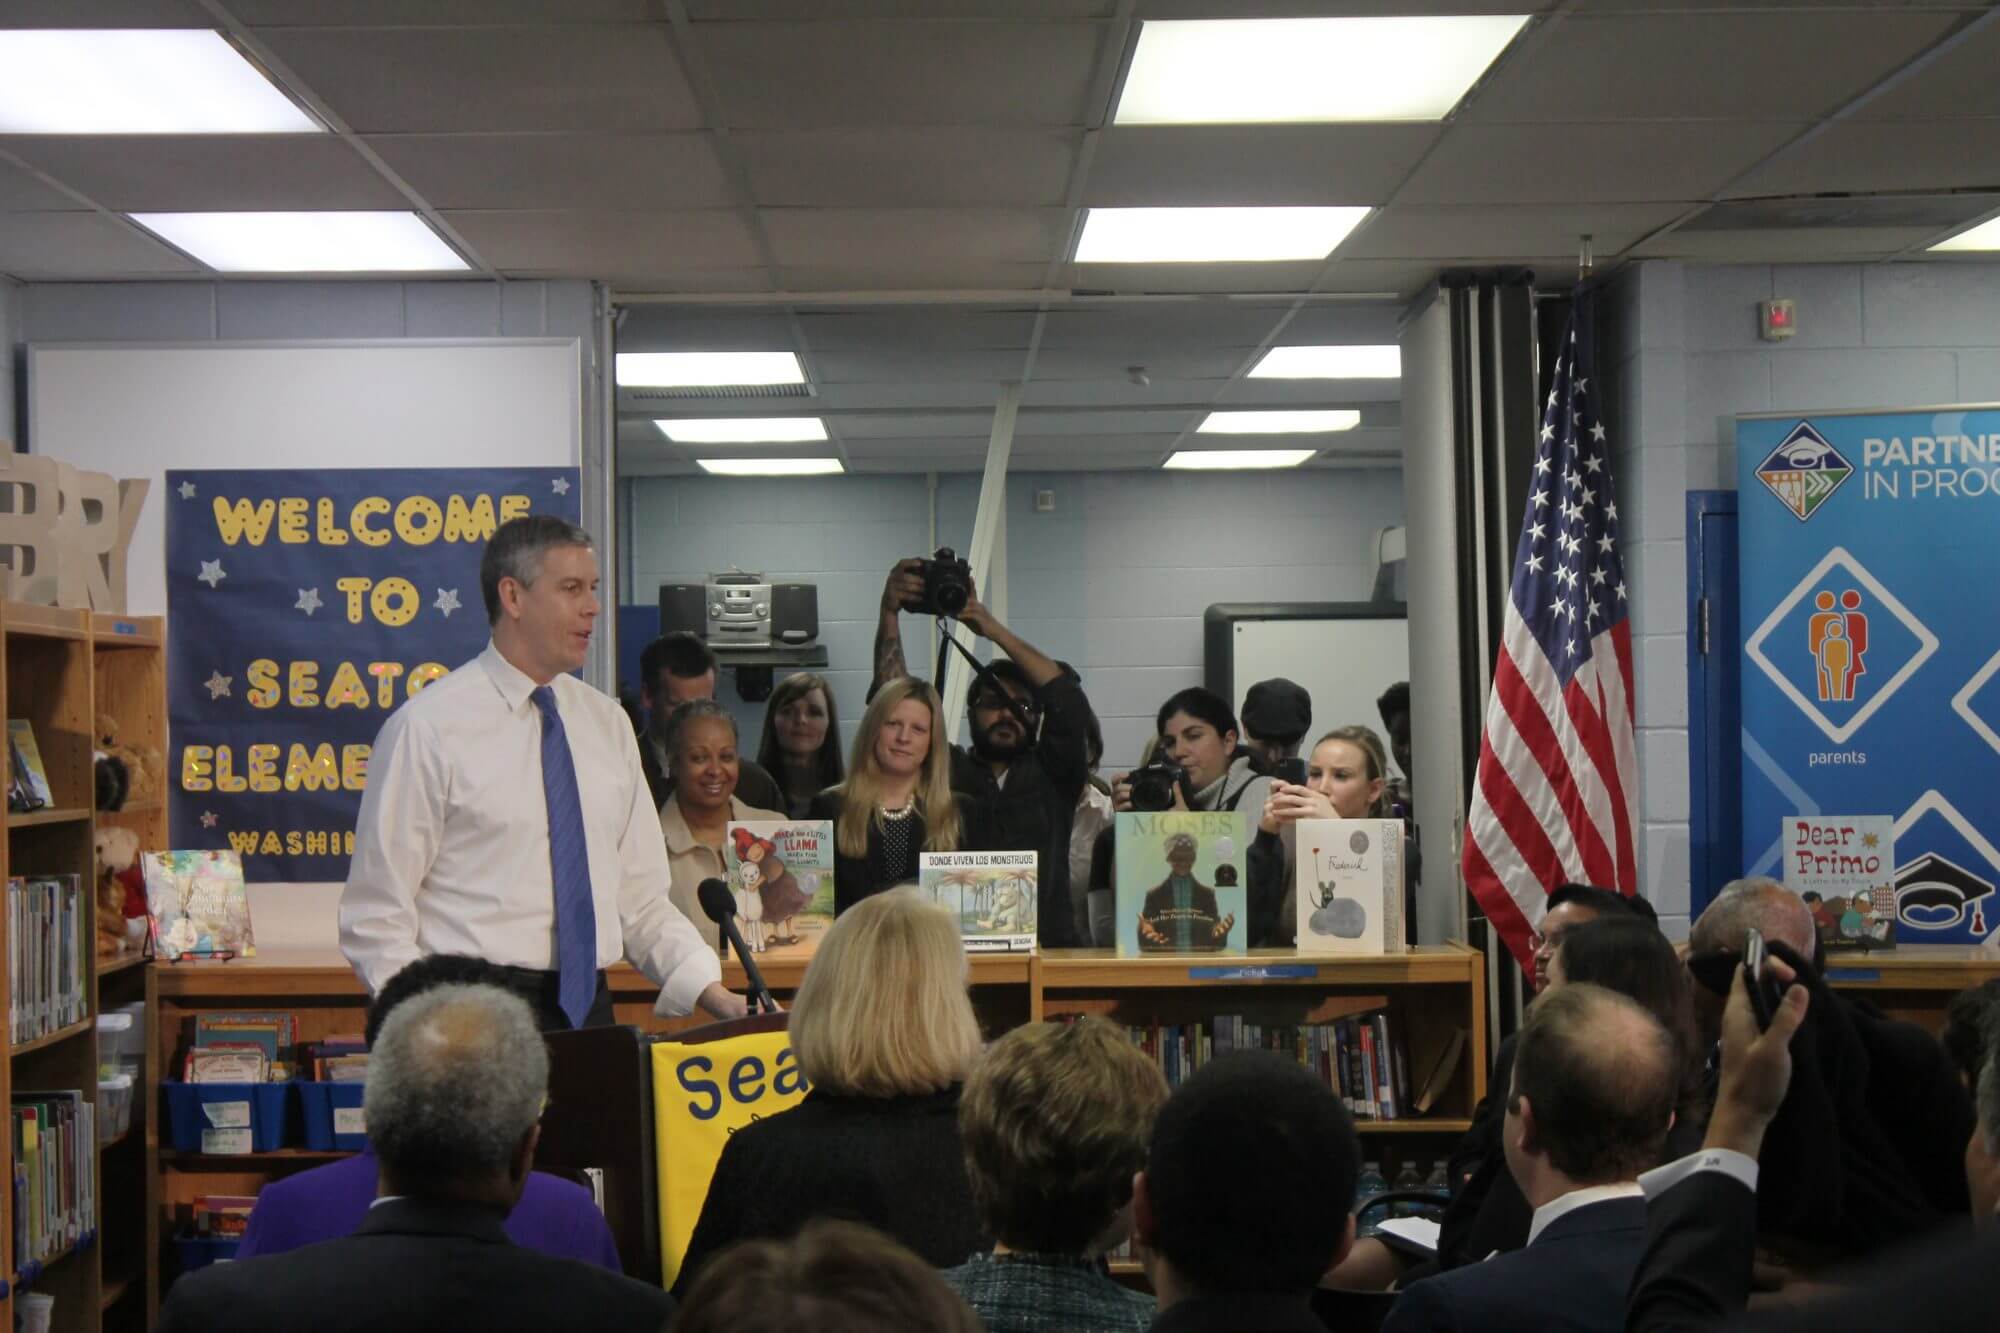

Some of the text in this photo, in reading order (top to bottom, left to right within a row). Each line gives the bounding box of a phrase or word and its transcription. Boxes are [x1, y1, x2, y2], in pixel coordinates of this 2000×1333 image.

[1864, 470, 1899, 499] IN
[336, 577, 419, 626] TO
[182, 743, 374, 792] ELEME
[1809, 751, 1867, 767] parents
[1132, 814, 1233, 836] MOSES
[1796, 822, 1855, 846] Dear
[784, 839, 818, 851] LLAMA
[929, 854, 1033, 866] DONDE VIVEN LOS MONSTRUOS
[1796, 850, 1880, 874] Primo
[676, 1047, 808, 1120] Sea
